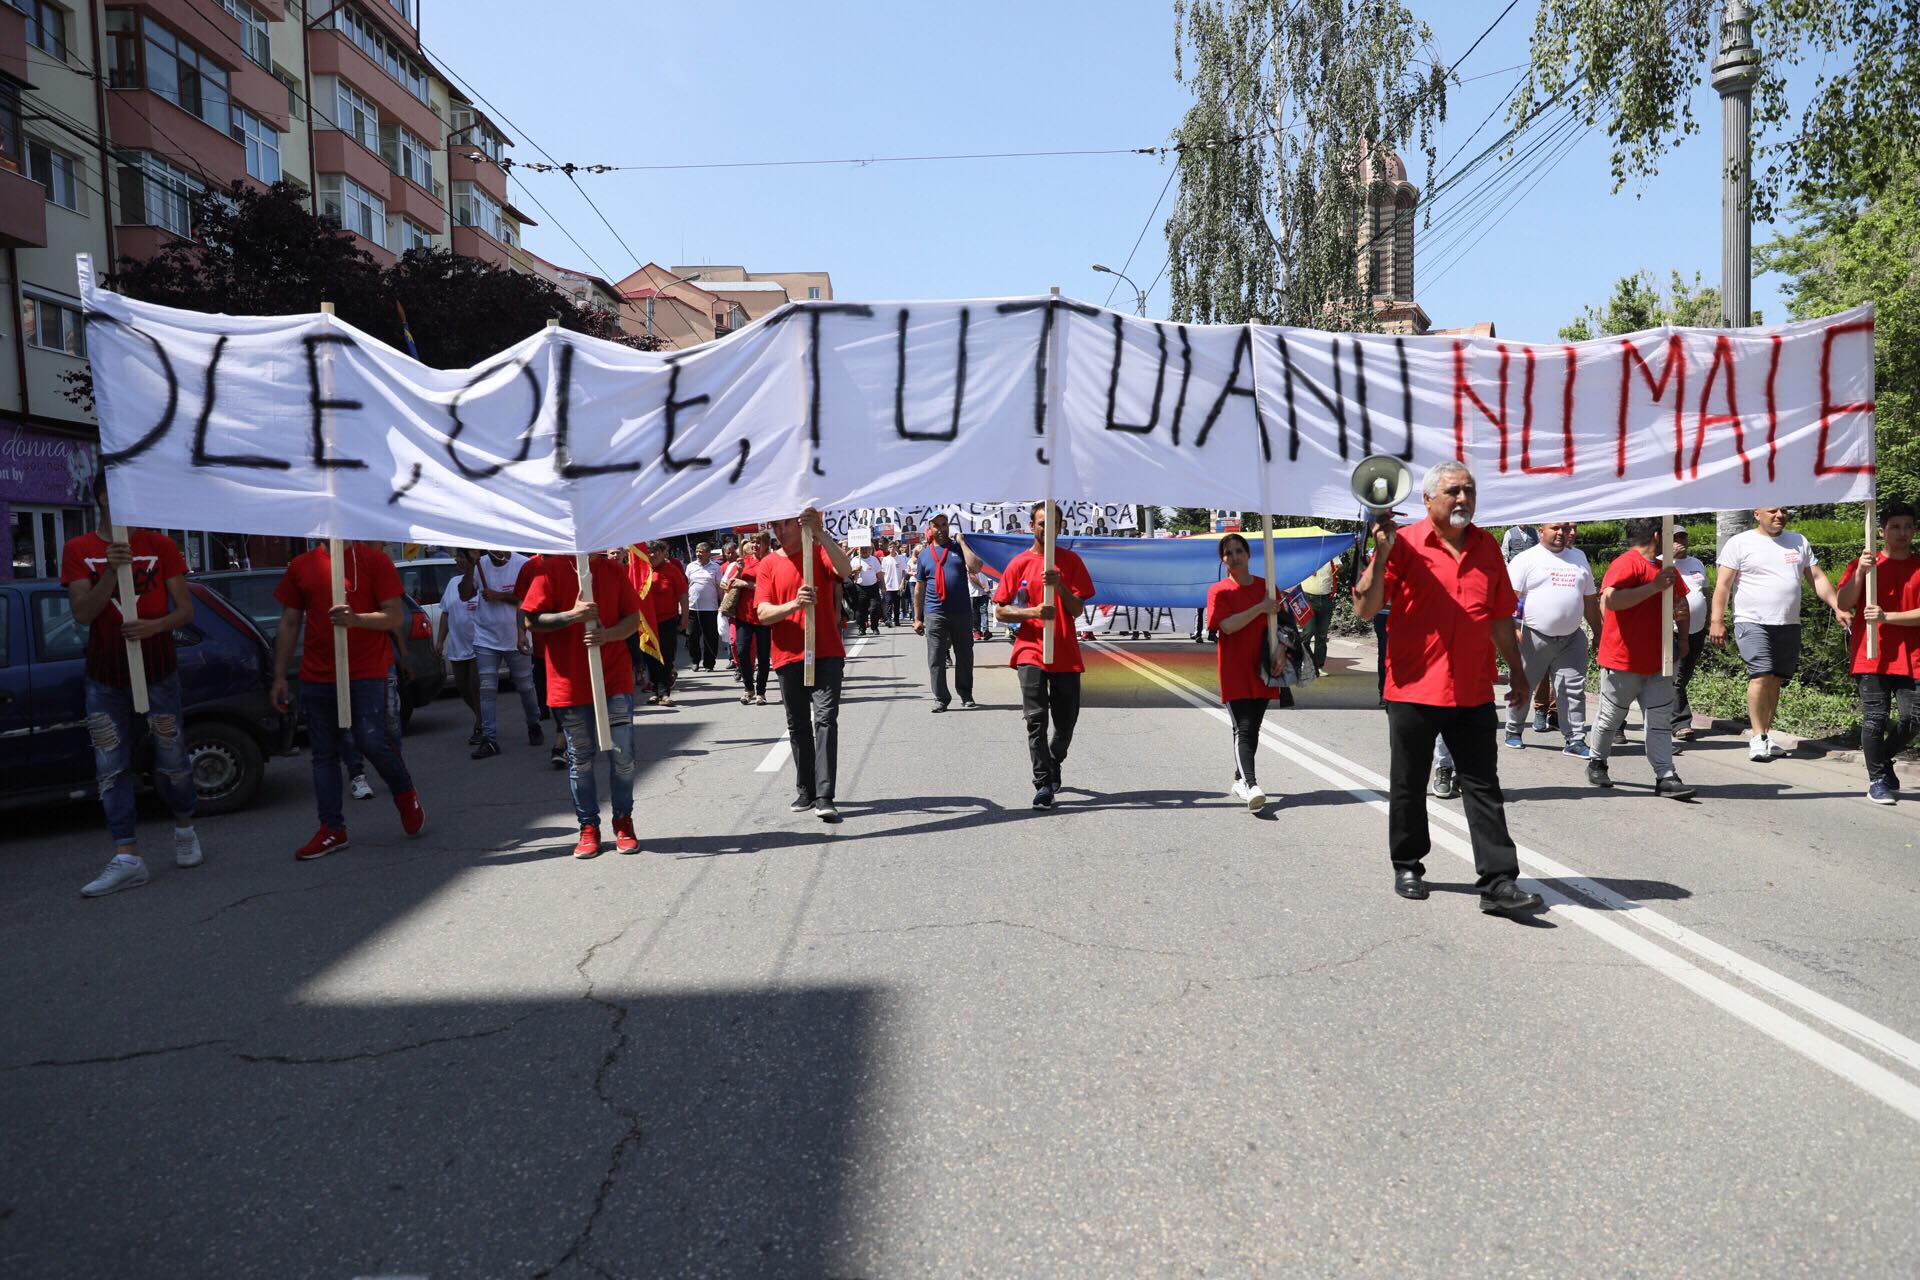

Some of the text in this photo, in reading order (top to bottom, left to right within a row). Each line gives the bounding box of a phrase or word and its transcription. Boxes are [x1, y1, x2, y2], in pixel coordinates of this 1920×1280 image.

[1453, 341, 1577, 475] NU
[1616, 335, 1782, 484] MAI
[3, 425, 70, 461] donna
[12, 467, 24, 484] by
